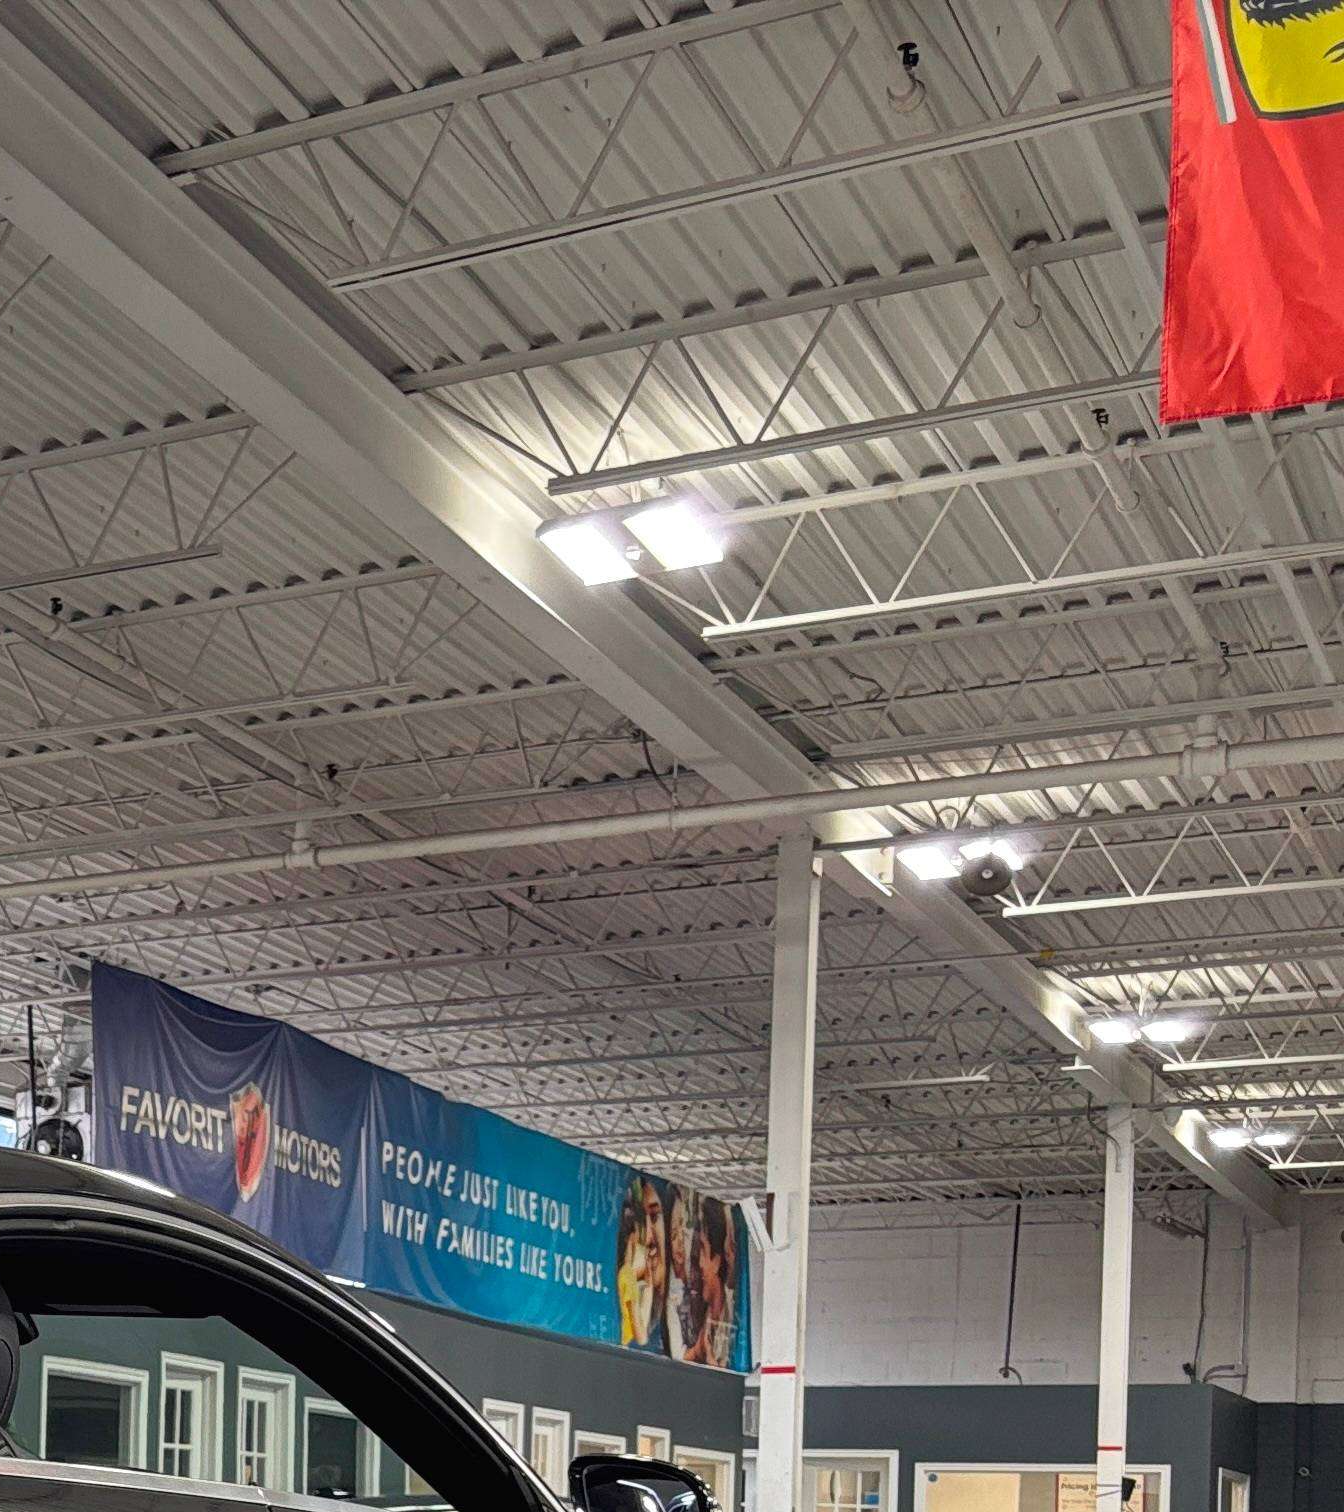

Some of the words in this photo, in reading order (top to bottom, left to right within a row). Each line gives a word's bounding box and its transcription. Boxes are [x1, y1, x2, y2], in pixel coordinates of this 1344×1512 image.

[120, 1086, 227, 1153] FAVORIT
[273, 1122, 342, 1188] MOTORS
[382, 1200, 428, 1245] WITH
[436, 1218, 514, 1269] FAMILIES
[520, 1243, 547, 1280] LIKE
[554, 1253, 609, 1294] YOURS.
[460, 1170, 499, 1210] JUST
[505, 1184, 538, 1222] LIKE
[541, 1196, 575, 1237] YOU.
